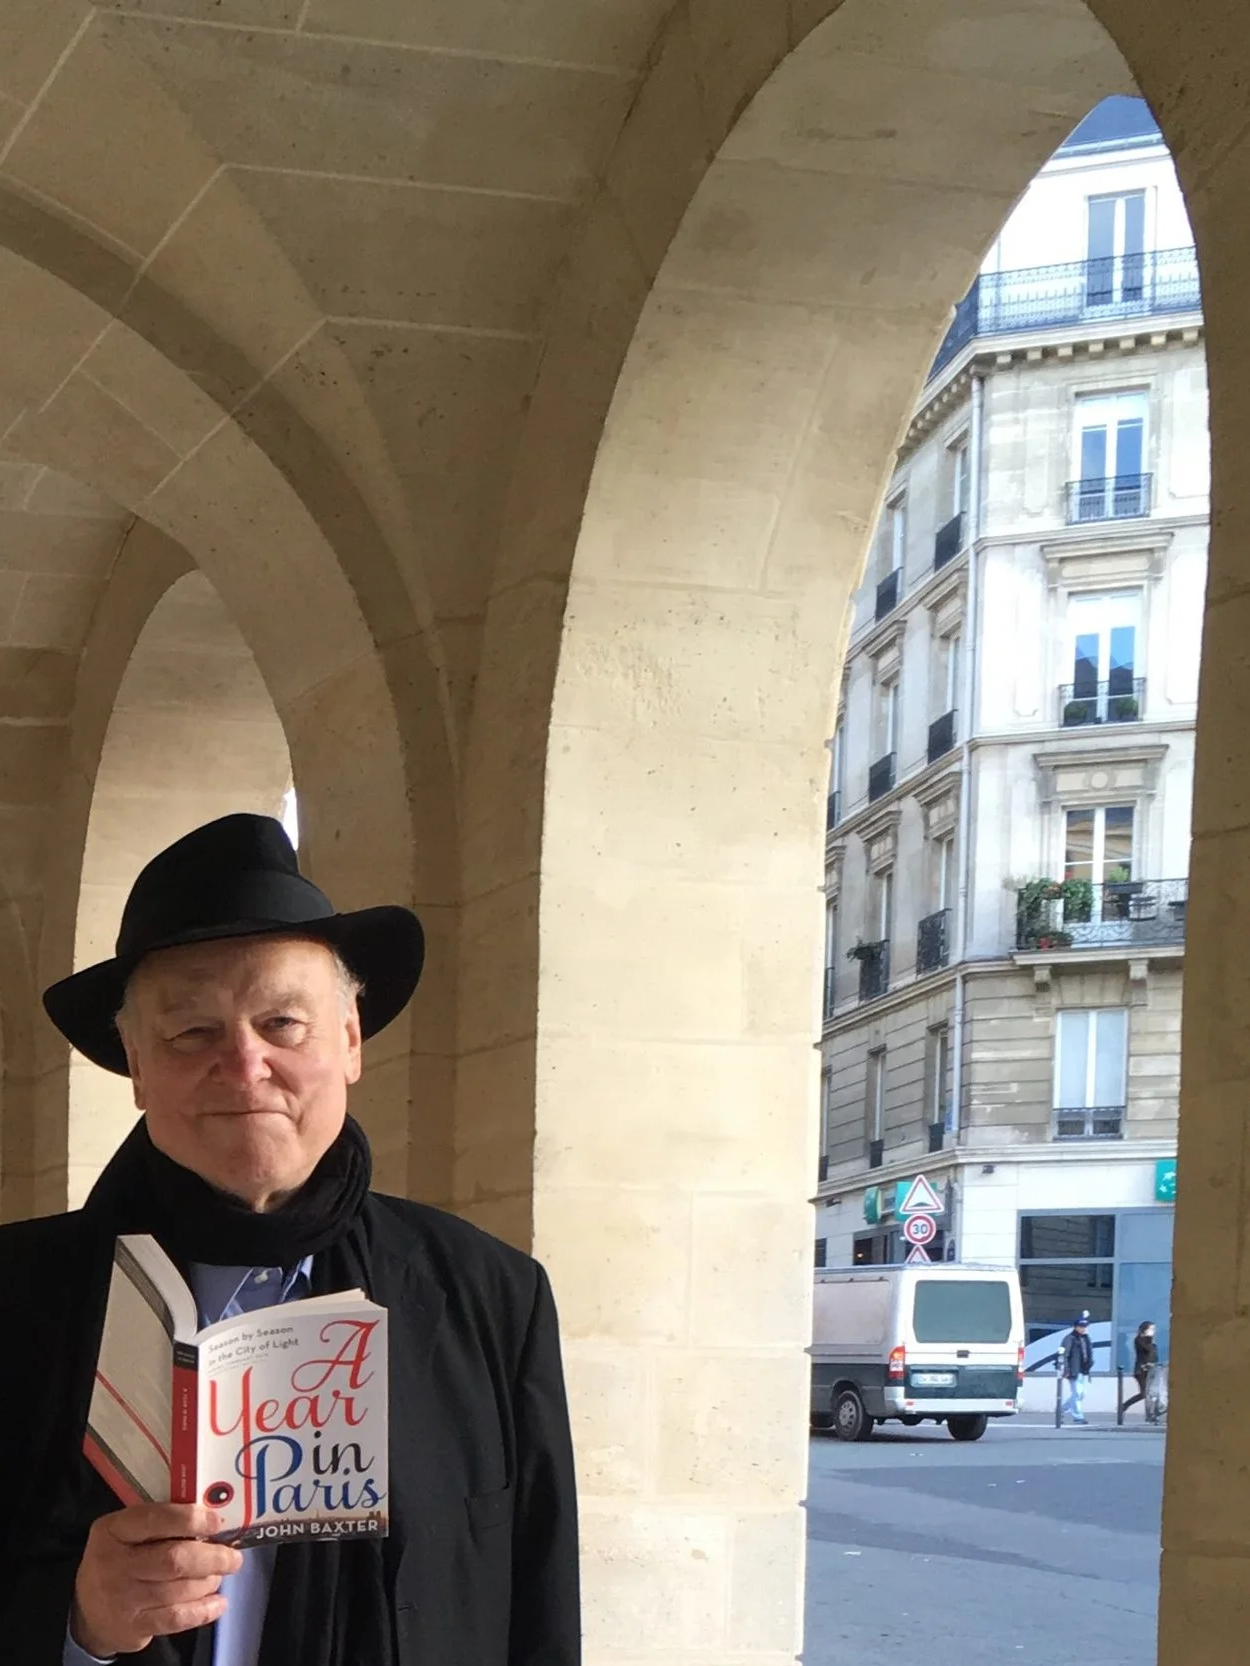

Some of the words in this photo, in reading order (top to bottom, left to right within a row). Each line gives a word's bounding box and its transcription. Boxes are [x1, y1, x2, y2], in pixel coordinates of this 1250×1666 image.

[912, 1223, 928, 1234] 30
[209, 1336, 239, 1353] Season
[242, 1332, 253, 1341] by
[256, 1327, 294, 1337] Season
[218, 1352, 233, 1361] the
[236, 1345, 256, 1356] City
[258, 1341, 269, 1351] of
[272, 1338, 299, 1350] Light
[291, 1319, 380, 1392] A
[313, 1430, 375, 1475] in
[235, 1435, 387, 1519] Paris
[256, 1523, 304, 1539] JOHN
[310, 1520, 378, 1534] BAXTER
